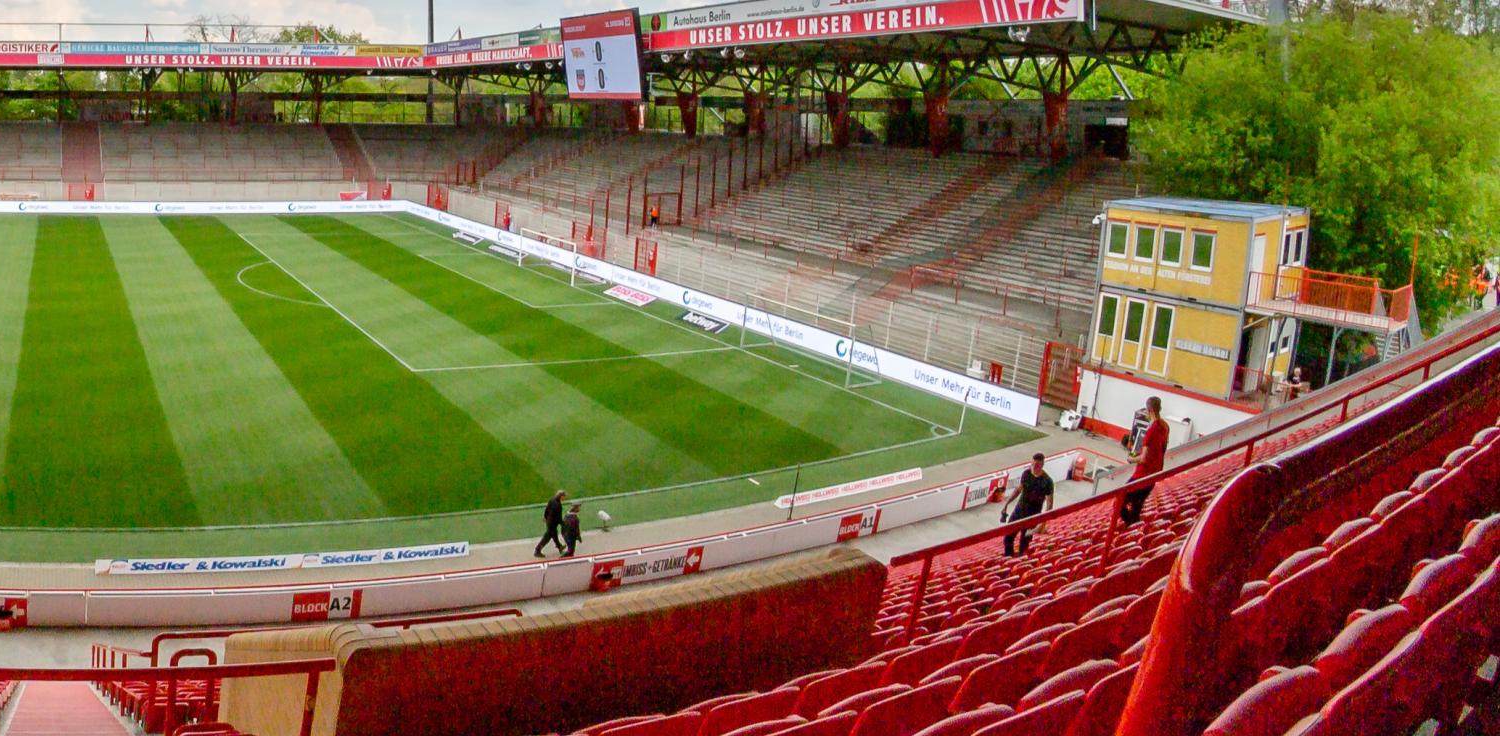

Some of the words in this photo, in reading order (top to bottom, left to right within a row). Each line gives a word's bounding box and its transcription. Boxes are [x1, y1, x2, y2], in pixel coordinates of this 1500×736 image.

[673, 13, 707, 26] Autohaus
[709, 9, 731, 22] Berlin
[690, 27, 732, 44] UNSER
[738, 21, 790, 41] STOLZ.
[797, 15, 852, 35] UNSER
[863, 5, 945, 31] VEREIN.
[125, 55, 165, 65] UNSER
[172, 55, 215, 65] STOLZ.
[221, 56, 260, 66] UNSER
[267, 56, 317, 66] VEREIN.
[595, 41, 602, 62] 0
[598, 68, 605, 89] 0
[914, 368, 938, 385] Unser
[941, 379, 965, 394] Mehr
[967, 386, 979, 400] für
[984, 391, 1012, 410] Berlin
[860, 516, 873, 530] A1
[131, 561, 190, 571] Siedler
[196, 560, 208, 571] &
[211, 557, 286, 570] Kowalski
[321, 554, 377, 565] Siedler
[383, 550, 395, 561] &
[398, 544, 466, 559] Kowalski
[622, 562, 648, 578] IMBISS
[652, 554, 686, 573] GETRÄNKE
[294, 602, 328, 614] BLOCK
[330, 597, 351, 611] A2
